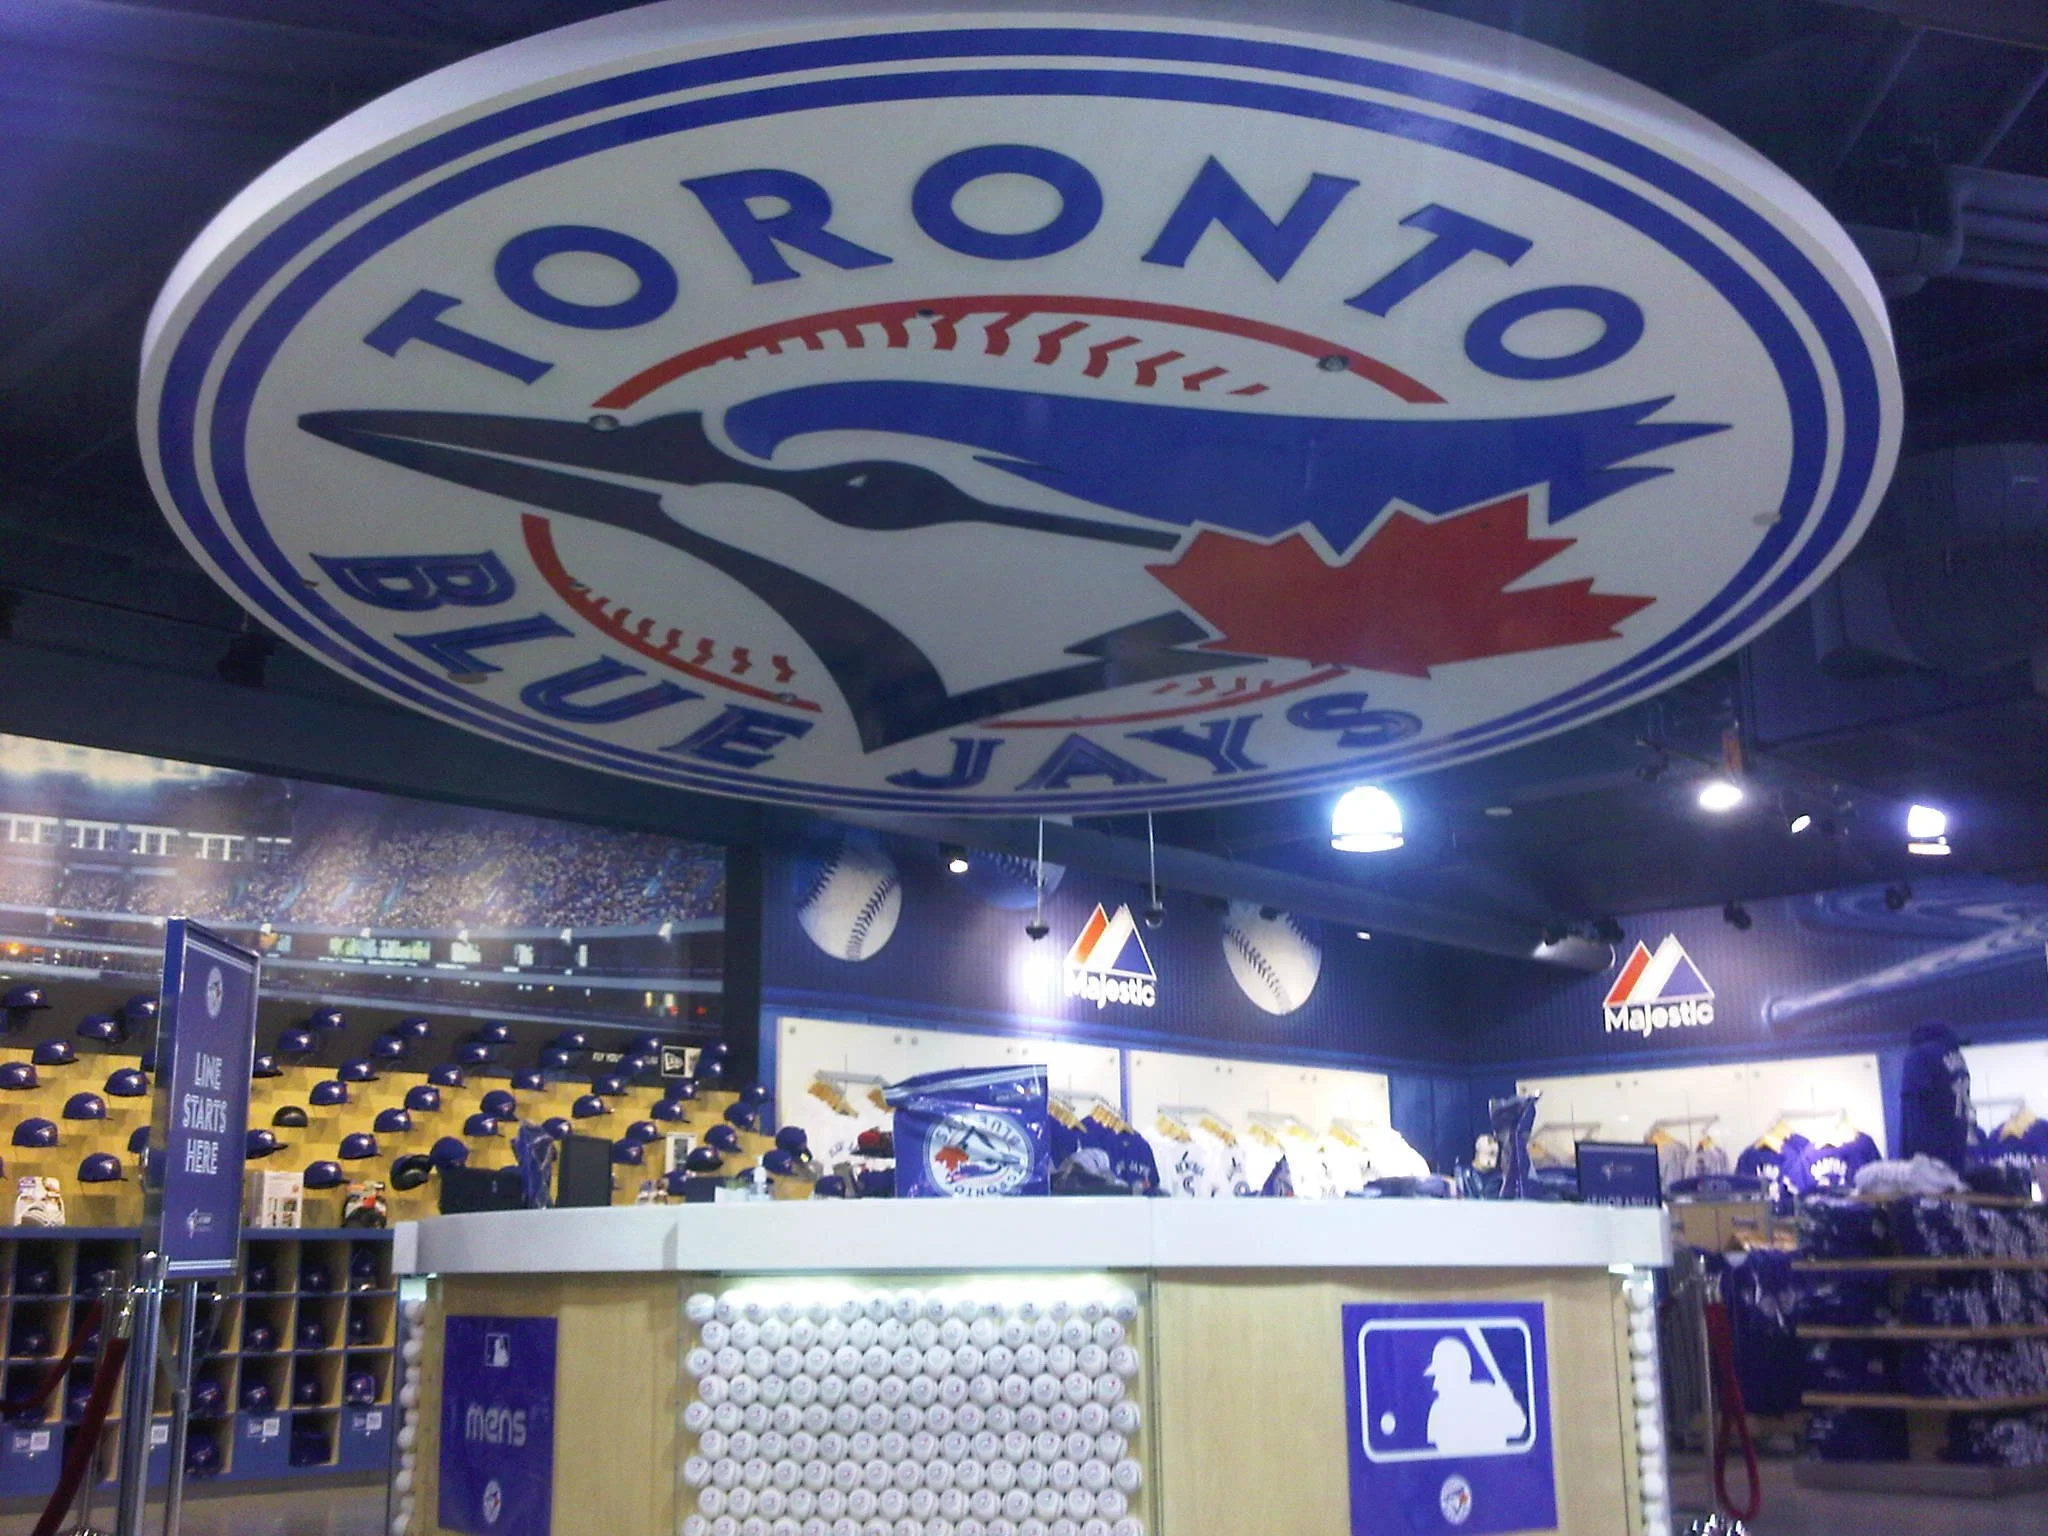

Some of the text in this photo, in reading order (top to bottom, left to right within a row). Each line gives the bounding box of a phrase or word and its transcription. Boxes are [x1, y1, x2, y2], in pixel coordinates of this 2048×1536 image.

[362, 144, 1645, 385] TORONTO
[309, 549, 1423, 792] BLUE JAYS
[1063, 969, 1155, 1009] Majestic
[1603, 998, 1714, 1037] Majestic
[195, 1052, 223, 1090] LINE
[183, 1094, 228, 1133] STARTS
[185, 1139, 219, 1175] HERE
[464, 1403, 527, 1448] mens
